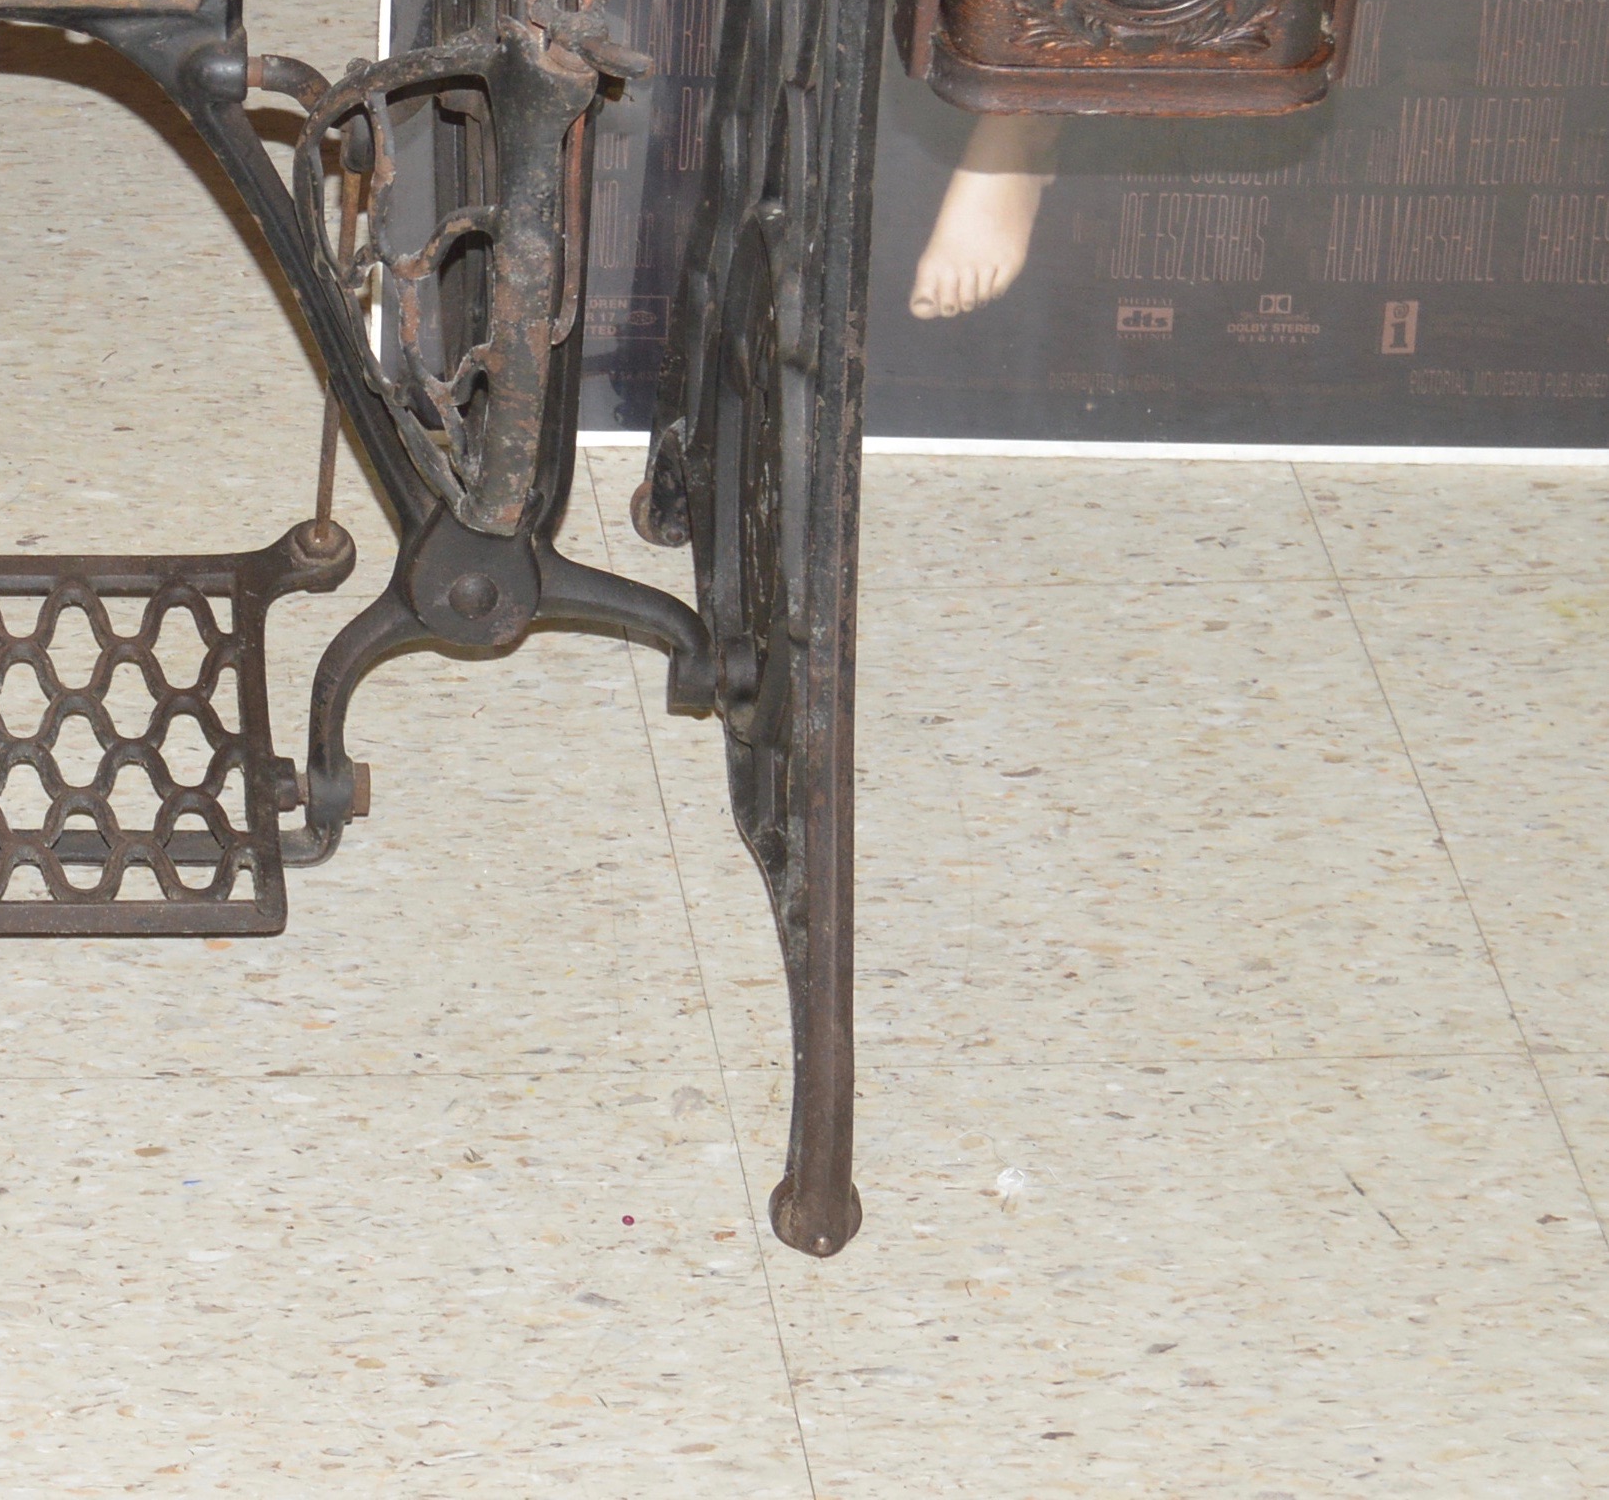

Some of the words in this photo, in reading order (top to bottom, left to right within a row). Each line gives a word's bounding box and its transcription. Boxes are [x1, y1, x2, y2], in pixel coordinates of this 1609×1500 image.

[1395, 97, 1462, 185] MARK
[1110, 192, 1150, 280] JOE
[1153, 192, 1270, 282] ESZTERHAS
[1324, 194, 1384, 282] ALAN
[1388, 194, 1498, 282] MARSHALL
[1121, 310, 1169, 328] dts
[1227, 323, 1268, 334] DOLBY
[1272, 323, 1321, 335] STEREO
